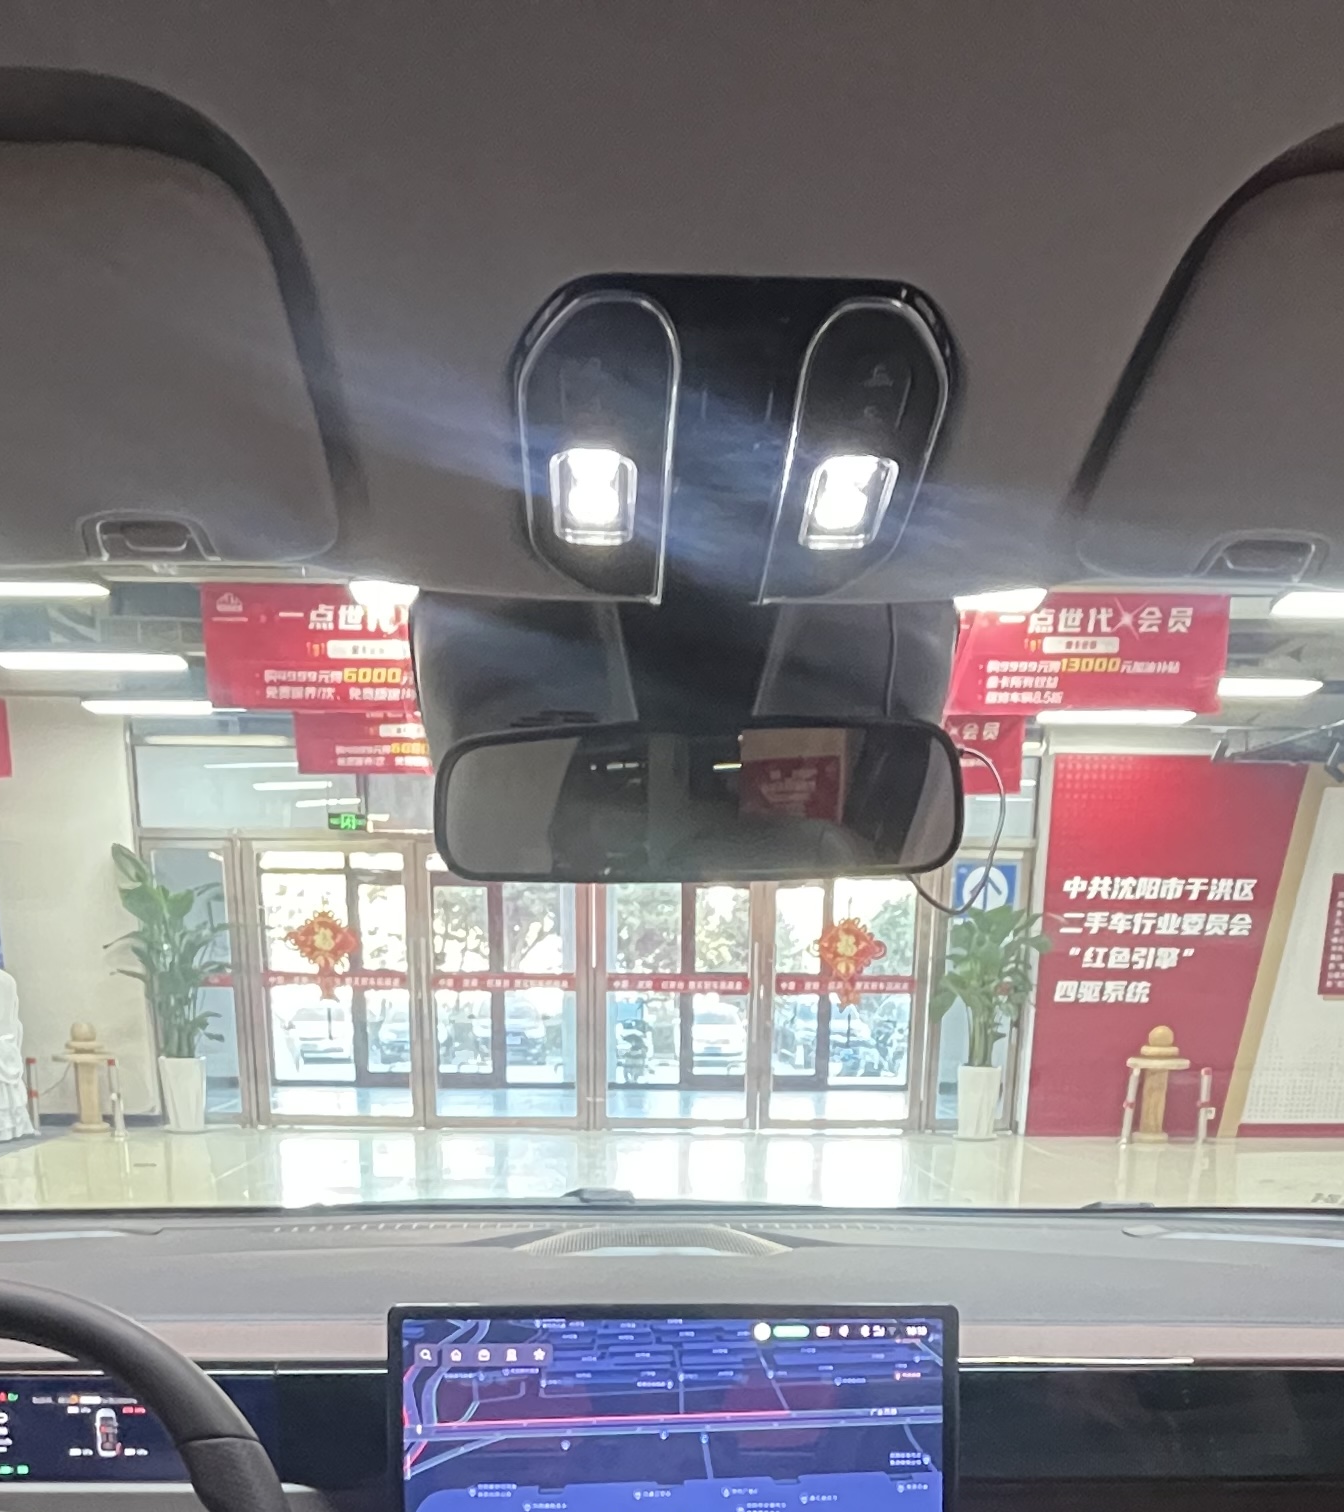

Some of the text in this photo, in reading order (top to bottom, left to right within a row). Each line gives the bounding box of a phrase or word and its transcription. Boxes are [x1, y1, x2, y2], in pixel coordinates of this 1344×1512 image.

[1062, 875, 1258, 901] 中共沈阳市于洪区
[1059, 911, 1253, 936] 二手车行业委员会
[1053, 980, 1152, 1003] 四驱系统
